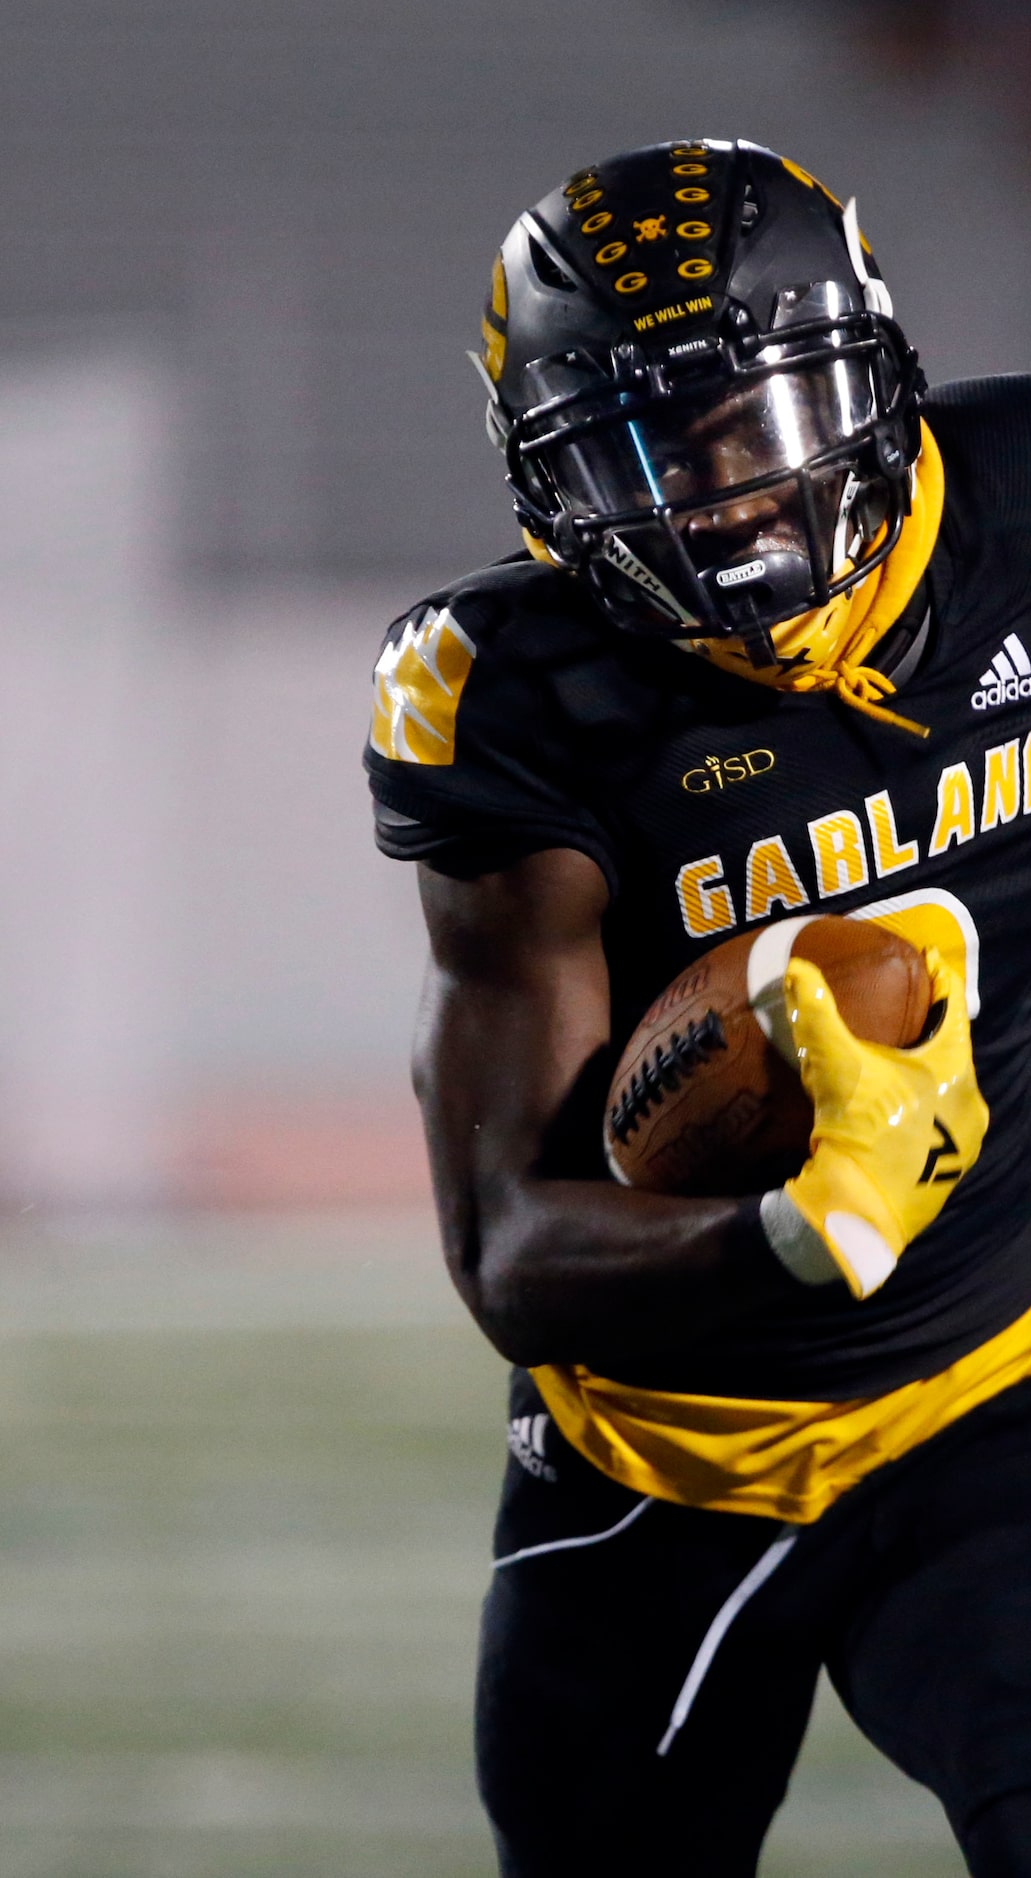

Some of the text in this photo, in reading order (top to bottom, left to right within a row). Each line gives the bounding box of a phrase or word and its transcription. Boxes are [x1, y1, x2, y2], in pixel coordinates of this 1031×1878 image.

[672, 163, 708, 177] G
[674, 186, 711, 204] G
[580, 211, 614, 234] G
[675, 220, 712, 240] G
[594, 241, 628, 265] G
[676, 258, 715, 280] G
[614, 271, 649, 294] G
[634, 296, 713, 331] WE WILL WIN
[668, 339, 707, 355] XENITH
[607, 541, 660, 592] NITH
[721, 563, 763, 584] BATTLE
[680, 748, 777, 795] GISD
